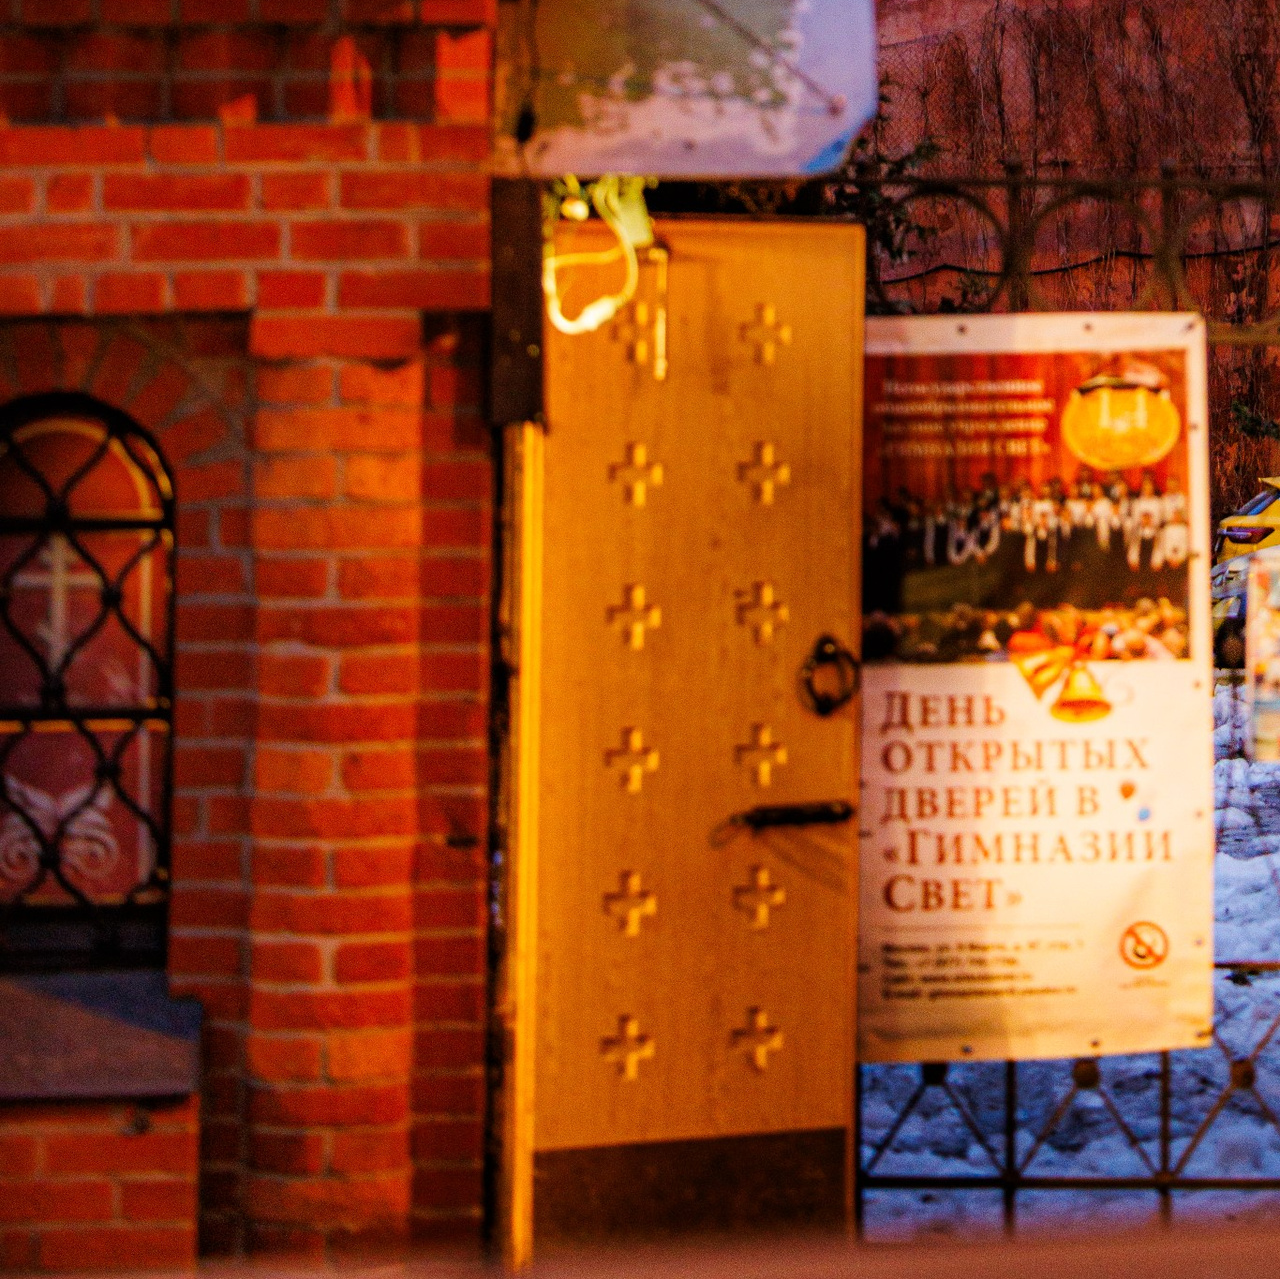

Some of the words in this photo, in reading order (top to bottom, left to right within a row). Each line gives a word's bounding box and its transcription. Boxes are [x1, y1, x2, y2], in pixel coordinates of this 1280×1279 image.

[880, 690, 1007, 733] ДЕНЬ
[880, 738, 1151, 774] ОТКРЫТЫХ
[880, 779, 1058, 825] ДВЕРЕЙ
[1076, 786, 1100, 818] В
[883, 830, 1174, 867] «ГИМНАЗИИ
